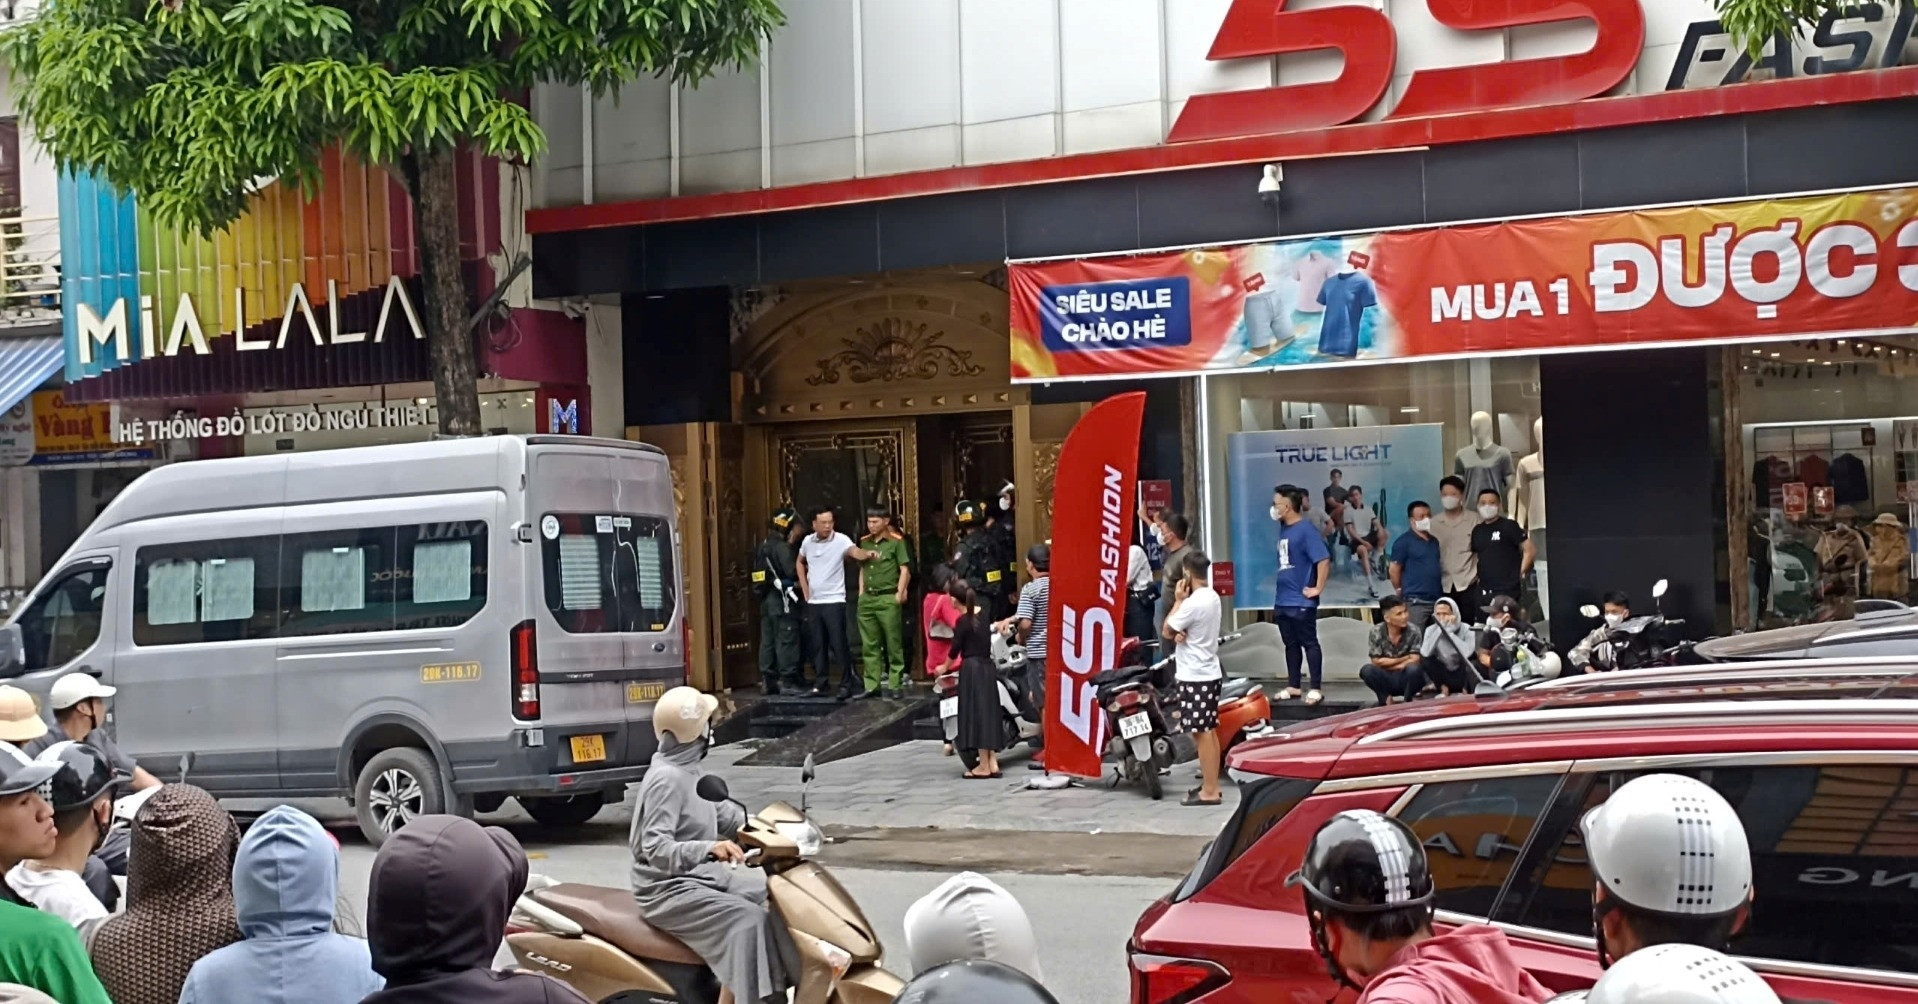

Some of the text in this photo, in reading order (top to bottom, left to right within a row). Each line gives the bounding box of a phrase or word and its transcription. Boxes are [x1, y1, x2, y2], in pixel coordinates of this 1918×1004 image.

[1431, 280, 1543, 323] MUA
[1549, 278, 1569, 315] 1
[1590, 221, 1879, 319] ĐƯỢC
[236, 275, 426, 351] LALA
[1056, 287, 1172, 315] SIÊU SALE
[1061, 314, 1165, 342] CHÀO HÈ
[38, 413, 95, 440] Vàng
[120, 418, 144, 446] HỆ
[147, 410, 213, 440] THỐNG
[216, 407, 245, 436] ĐỒ
[250, 409, 287, 434] LÓT
[552, 399, 579, 433] M
[1275, 444, 1392, 463] TRUE LIGHT
[1099, 464, 1123, 606] FASHION
